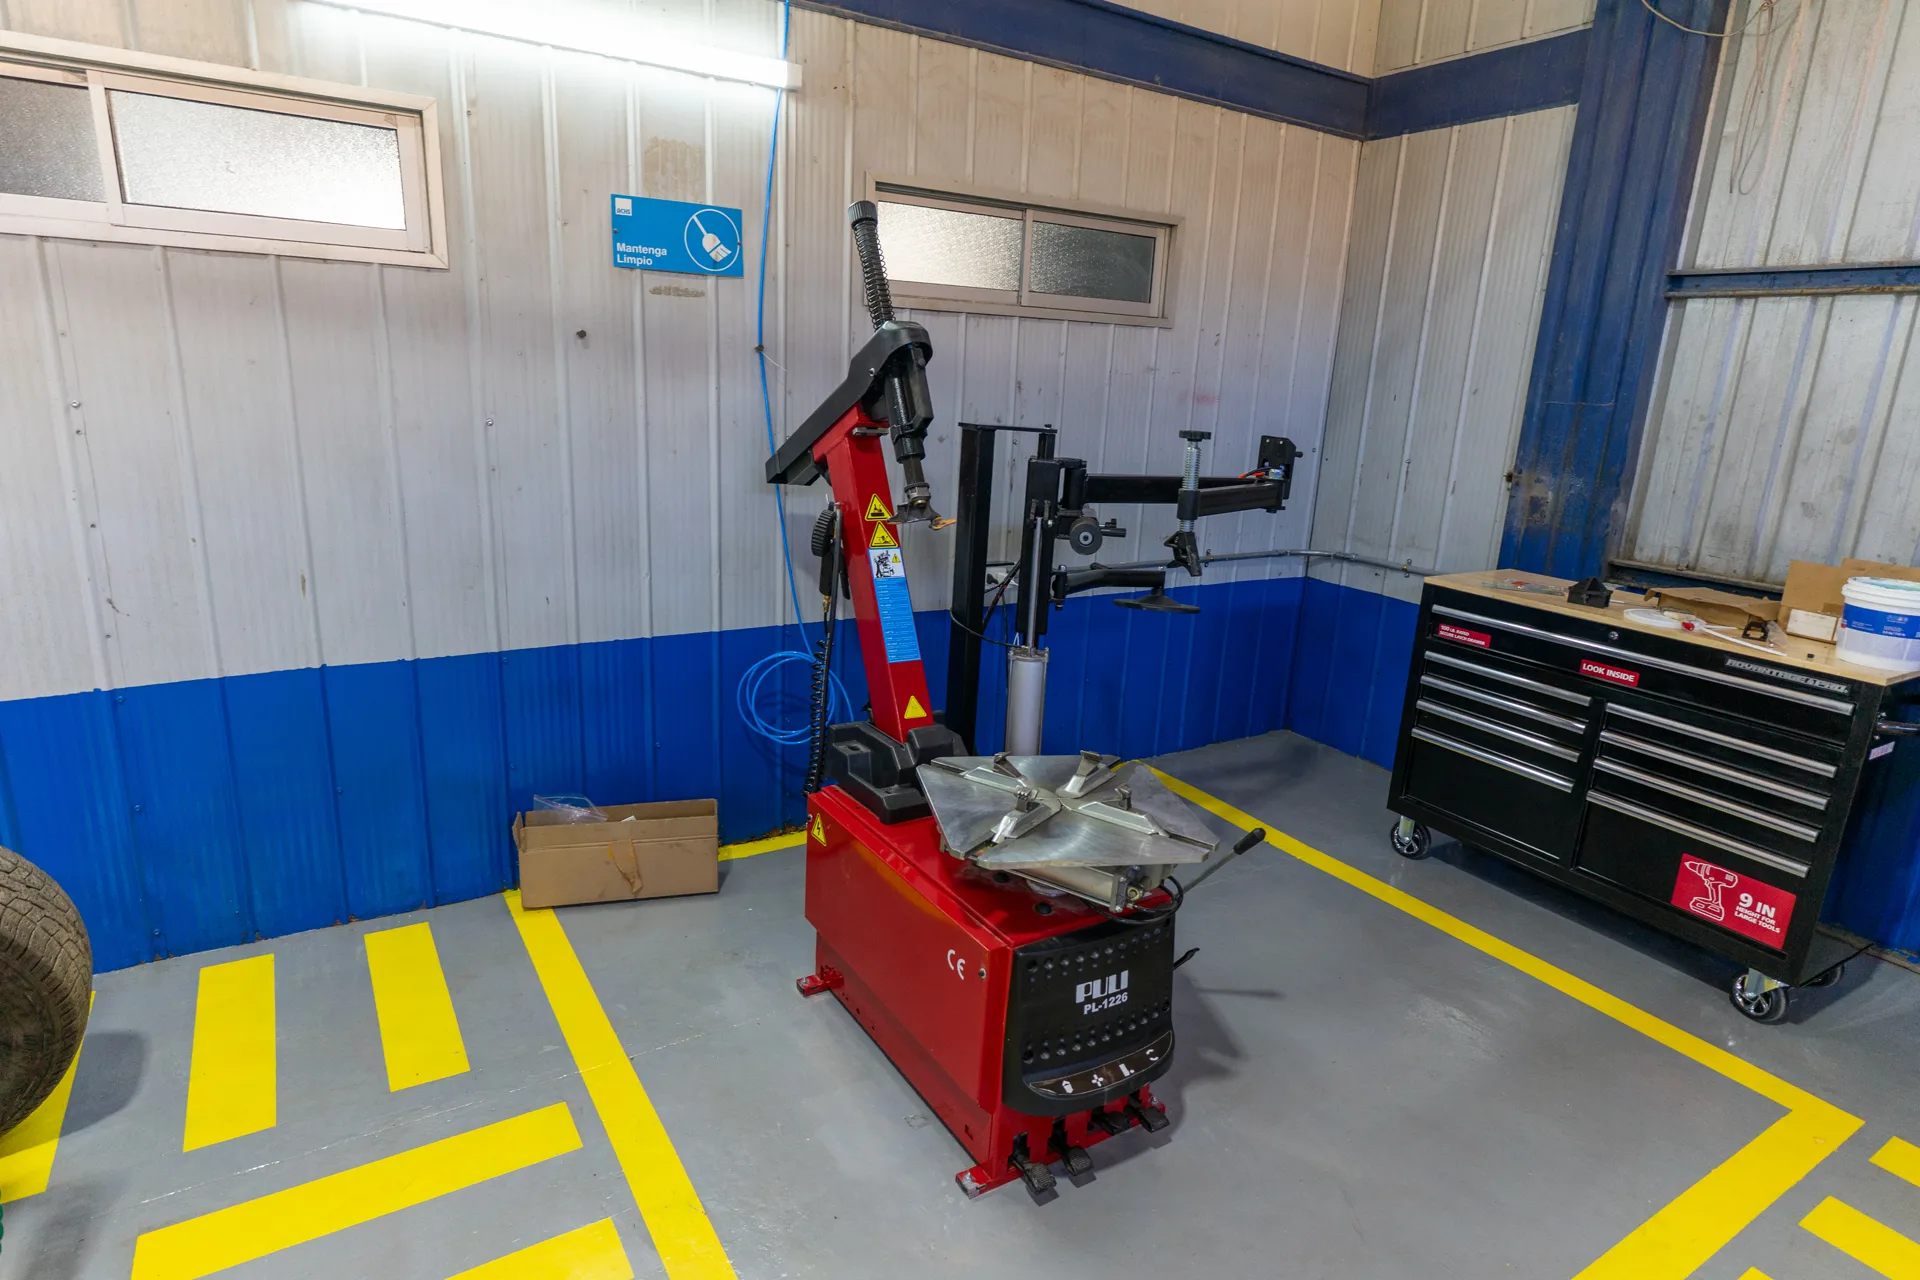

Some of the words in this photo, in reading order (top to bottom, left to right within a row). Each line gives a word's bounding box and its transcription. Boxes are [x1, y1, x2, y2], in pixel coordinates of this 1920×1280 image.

[616, 242, 668, 258] Mantenga
[617, 254, 653, 267] Limpio
[1582, 663, 1606, 675] LOOK
[1606, 669, 1635, 683] INSIDE
[1736, 906, 1761, 919] HEIGHT
[1761, 916, 1776, 926] FOR
[1739, 893, 1753, 908] 9
[1756, 902, 1776, 918] IN
[1734, 911, 1758, 925] LARGE
[1758, 920, 1781, 934] TOOLS
[947, 949, 966, 980] CE
[1076, 970, 1129, 1003] PULI
[1084, 992, 1129, 1015] PL-1226
